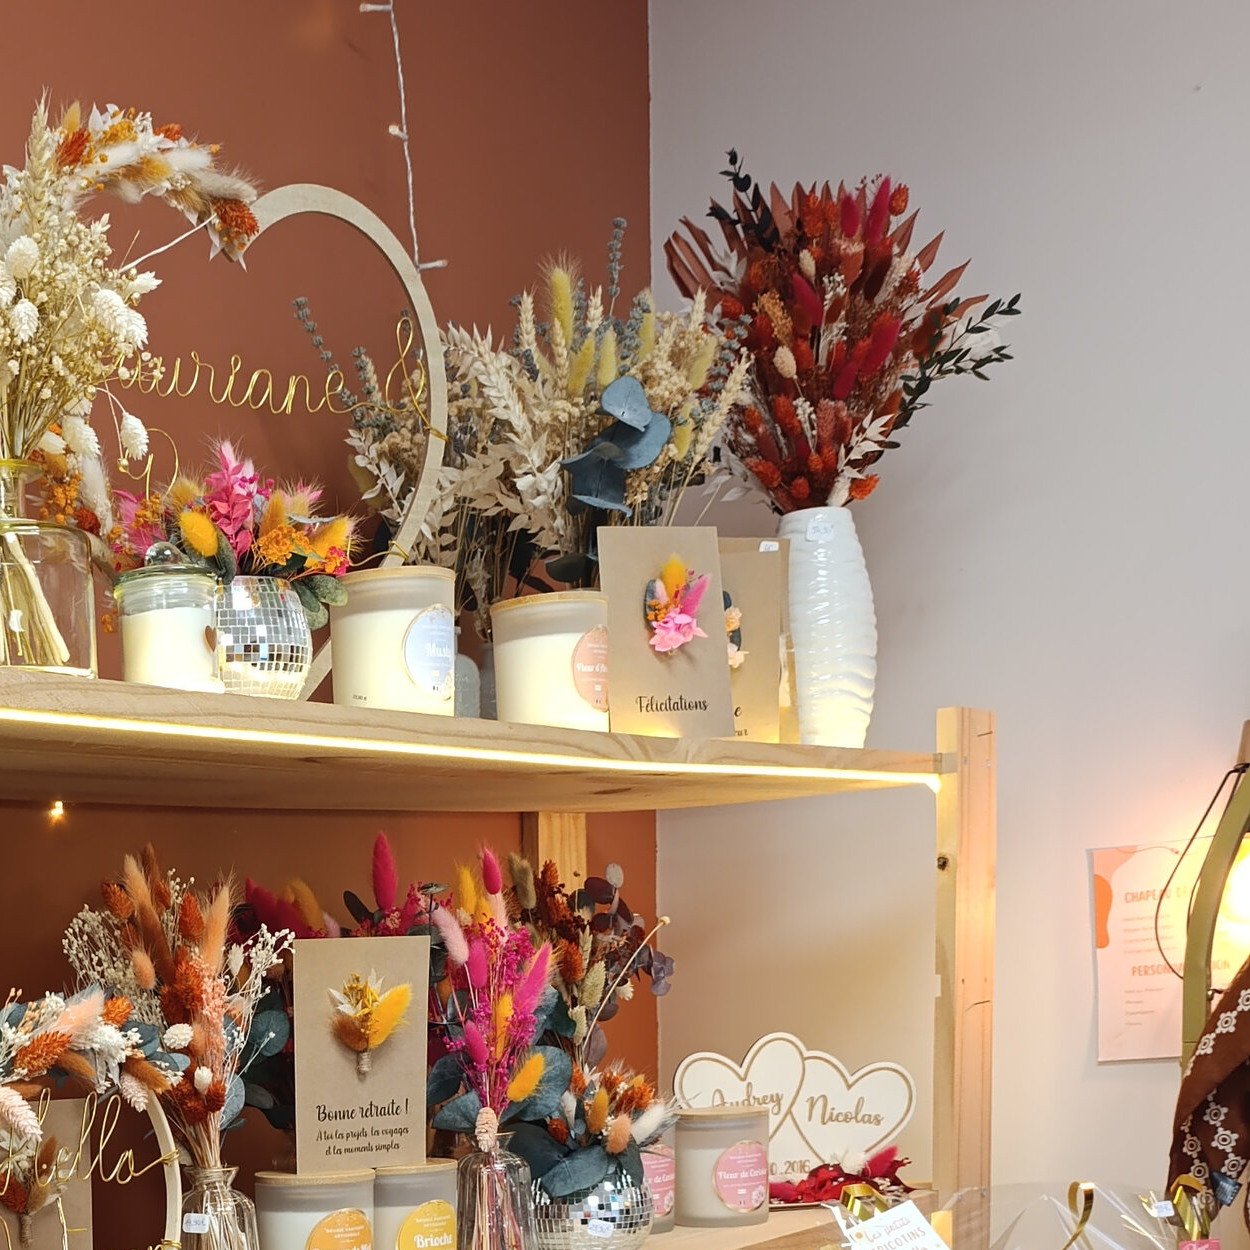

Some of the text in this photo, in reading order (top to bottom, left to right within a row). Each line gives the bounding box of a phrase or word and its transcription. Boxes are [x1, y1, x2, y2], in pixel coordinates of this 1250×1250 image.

[110, 350, 352, 415] auriane
[635, 695, 709, 713] Félicitations
[316, 1104, 357, 1122] Bonne
[359, 1099, 402, 1118] retraite
[806, 1094, 884, 1126] Nicolas
[335, 1129, 344, 1140] les
[333, 1145, 342, 1155] les
[344, 1142, 373, 1154] moments
[375, 1139, 400, 1152] simples
